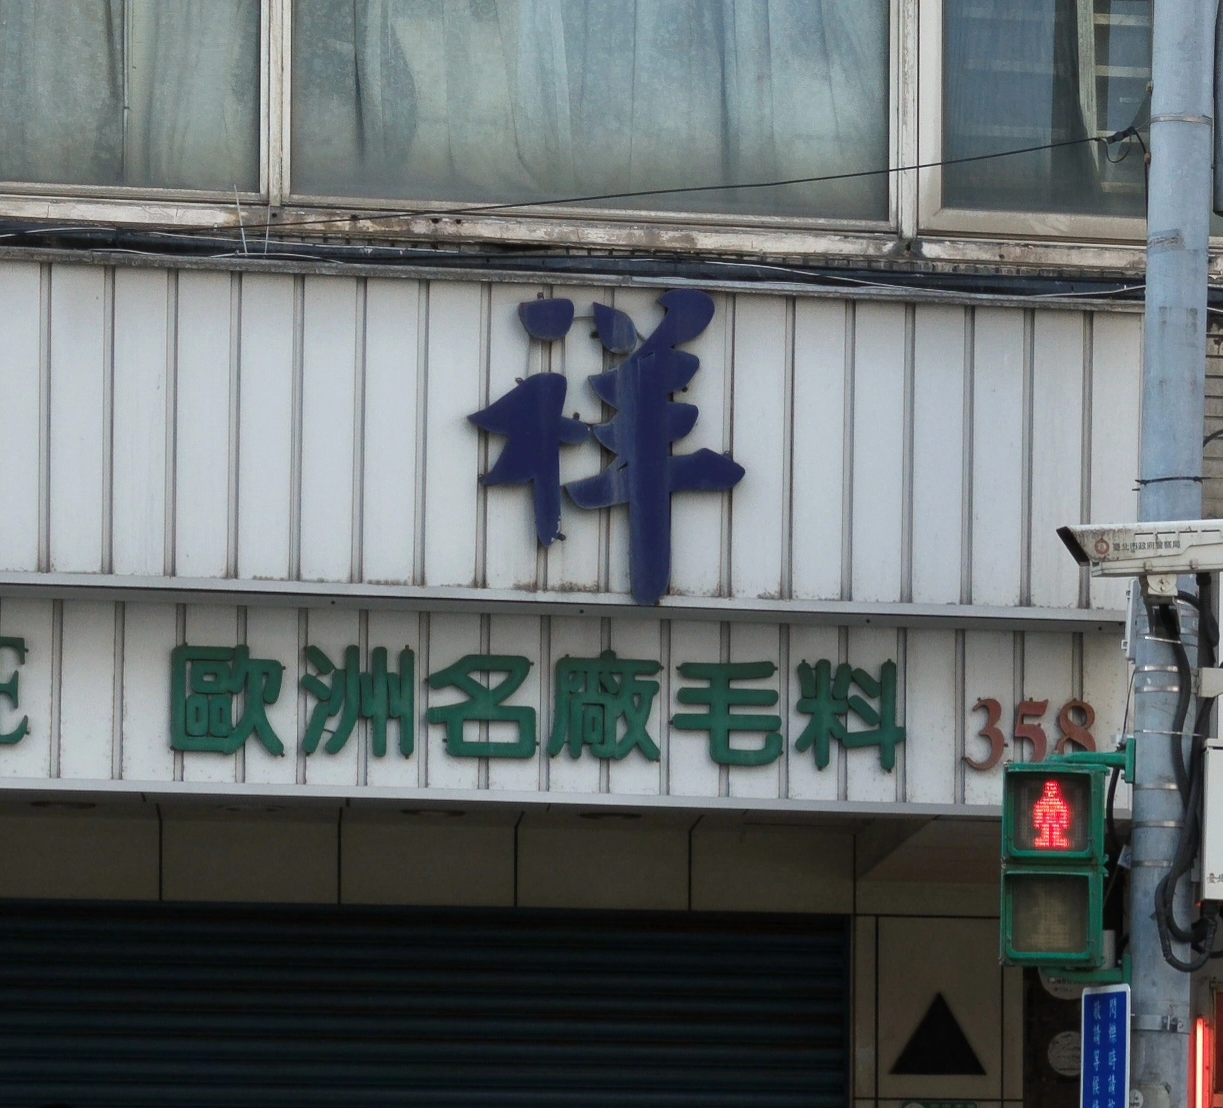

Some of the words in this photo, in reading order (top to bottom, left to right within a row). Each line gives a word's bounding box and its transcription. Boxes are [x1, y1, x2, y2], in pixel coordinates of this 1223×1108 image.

[467, 288, 745, 605] 祥
[170, 643, 906, 773] 歐洲名廠毛料
[962, 697, 1096, 771] 358
